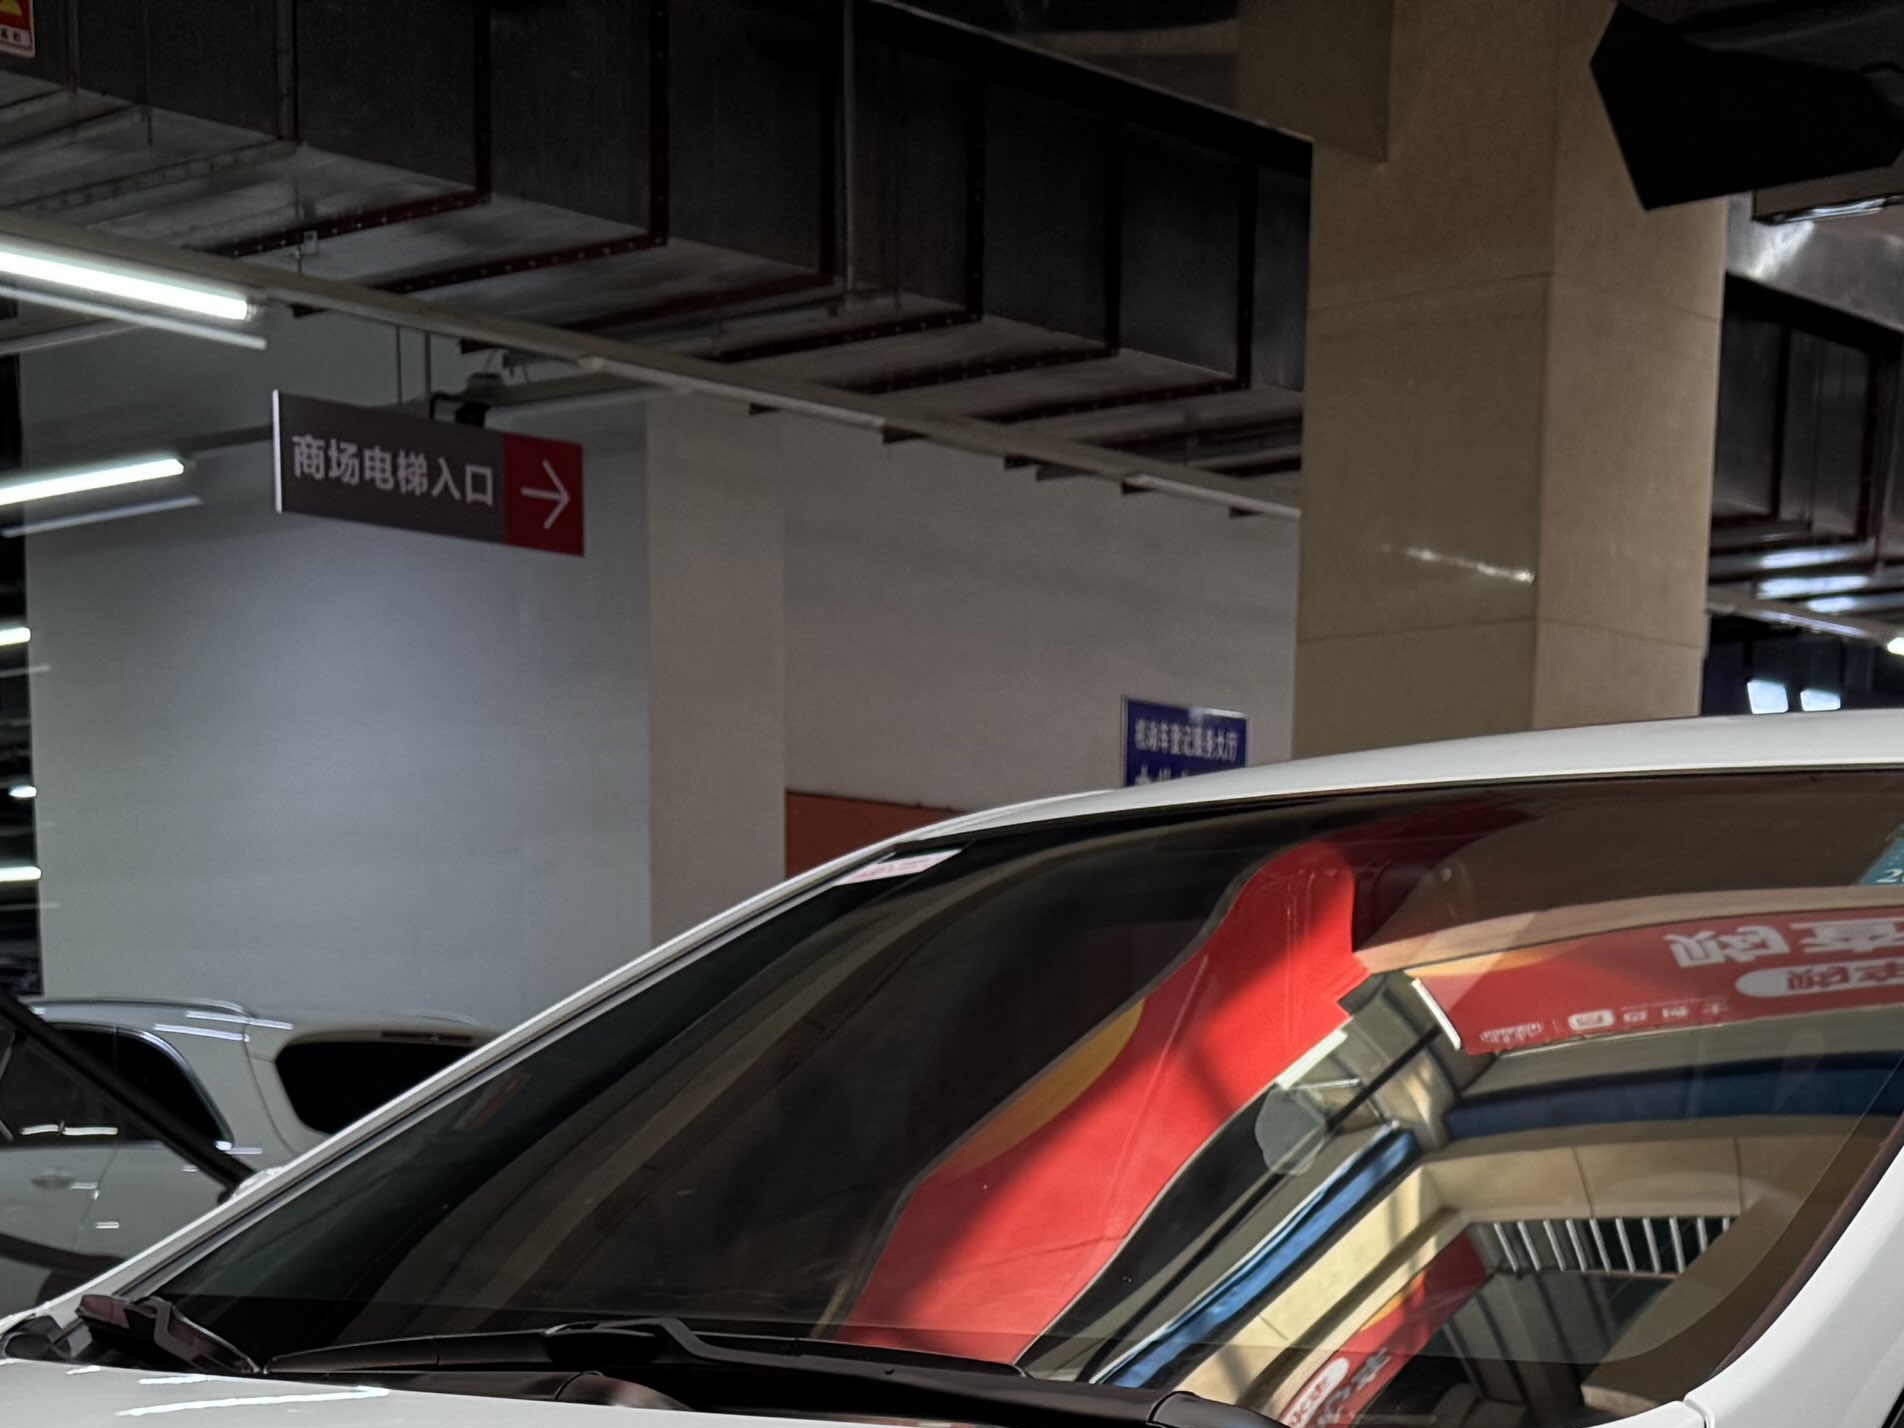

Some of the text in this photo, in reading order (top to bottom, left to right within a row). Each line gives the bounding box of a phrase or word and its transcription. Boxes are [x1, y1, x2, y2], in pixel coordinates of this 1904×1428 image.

[292, 433, 493, 507] 商场电梯入口
